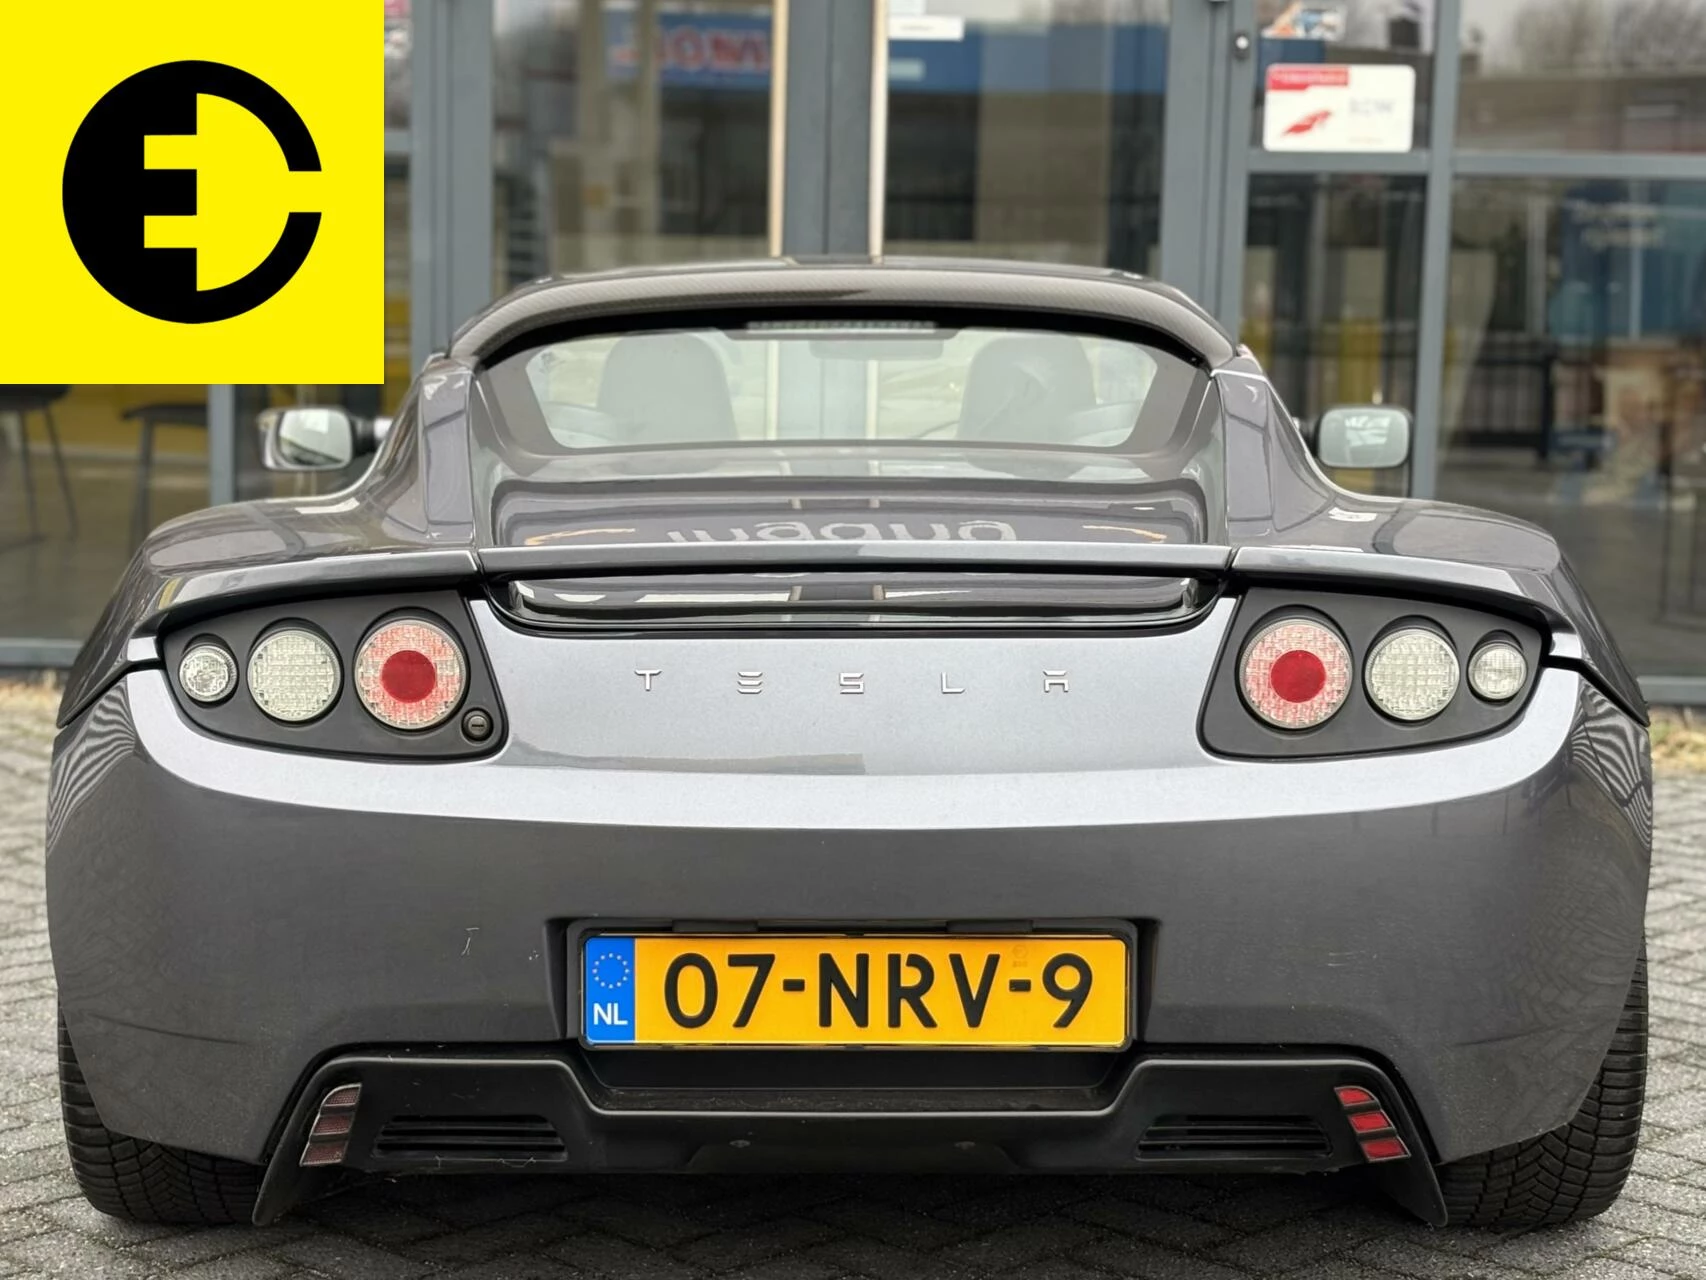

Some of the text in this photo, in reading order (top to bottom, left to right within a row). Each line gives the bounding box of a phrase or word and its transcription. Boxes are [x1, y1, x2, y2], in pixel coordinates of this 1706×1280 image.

[634, 669, 1070, 694] TESLA
[593, 952, 1094, 1029] NL 07-NRV-9
